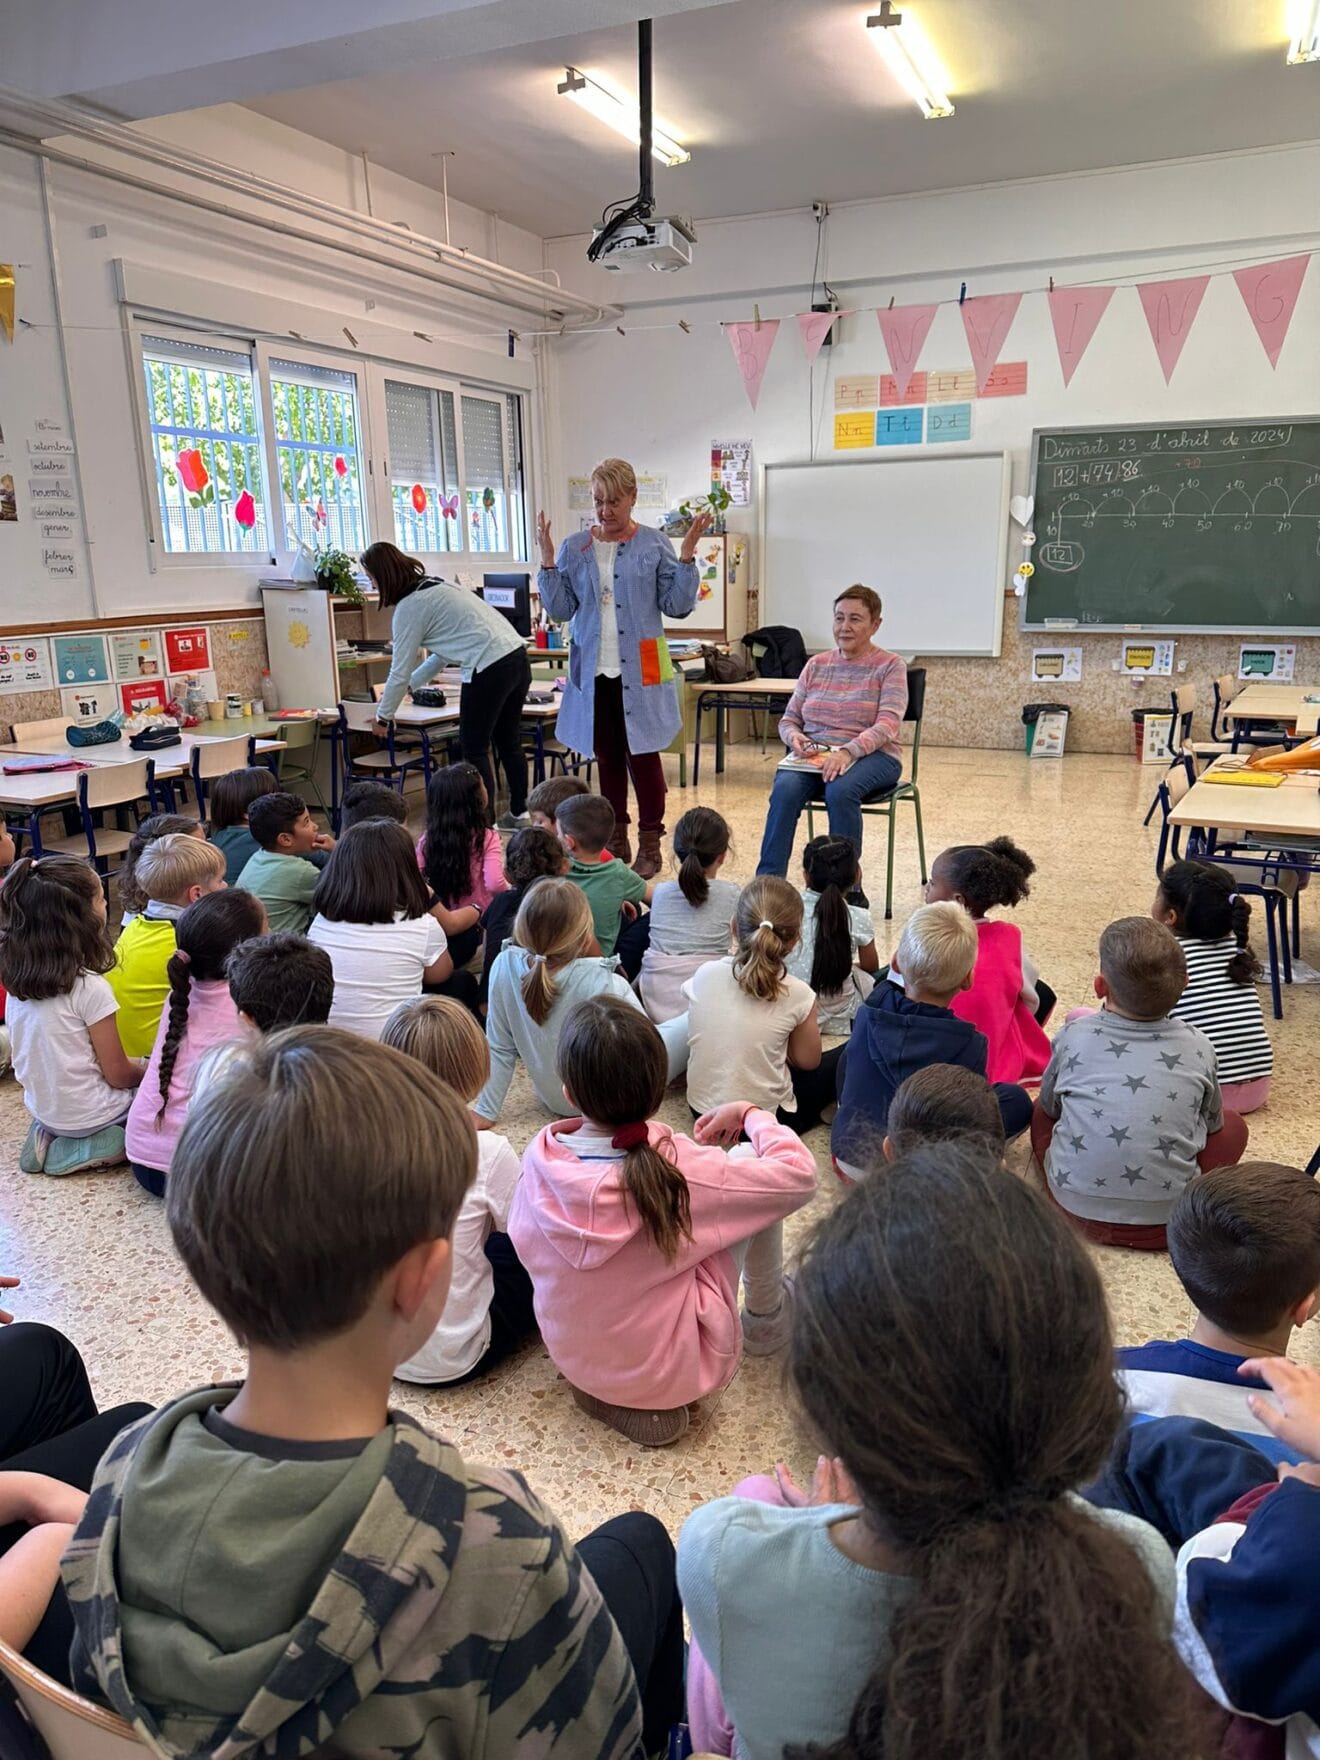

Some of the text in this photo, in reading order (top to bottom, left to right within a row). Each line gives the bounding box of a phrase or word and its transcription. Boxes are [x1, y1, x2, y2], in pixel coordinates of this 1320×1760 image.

[1044, 436, 1110, 459] Dimarts
[1118, 438, 1137, 452] 23
[1222, 431, 1240, 446] de
[1250, 429, 1285, 444] 2024
